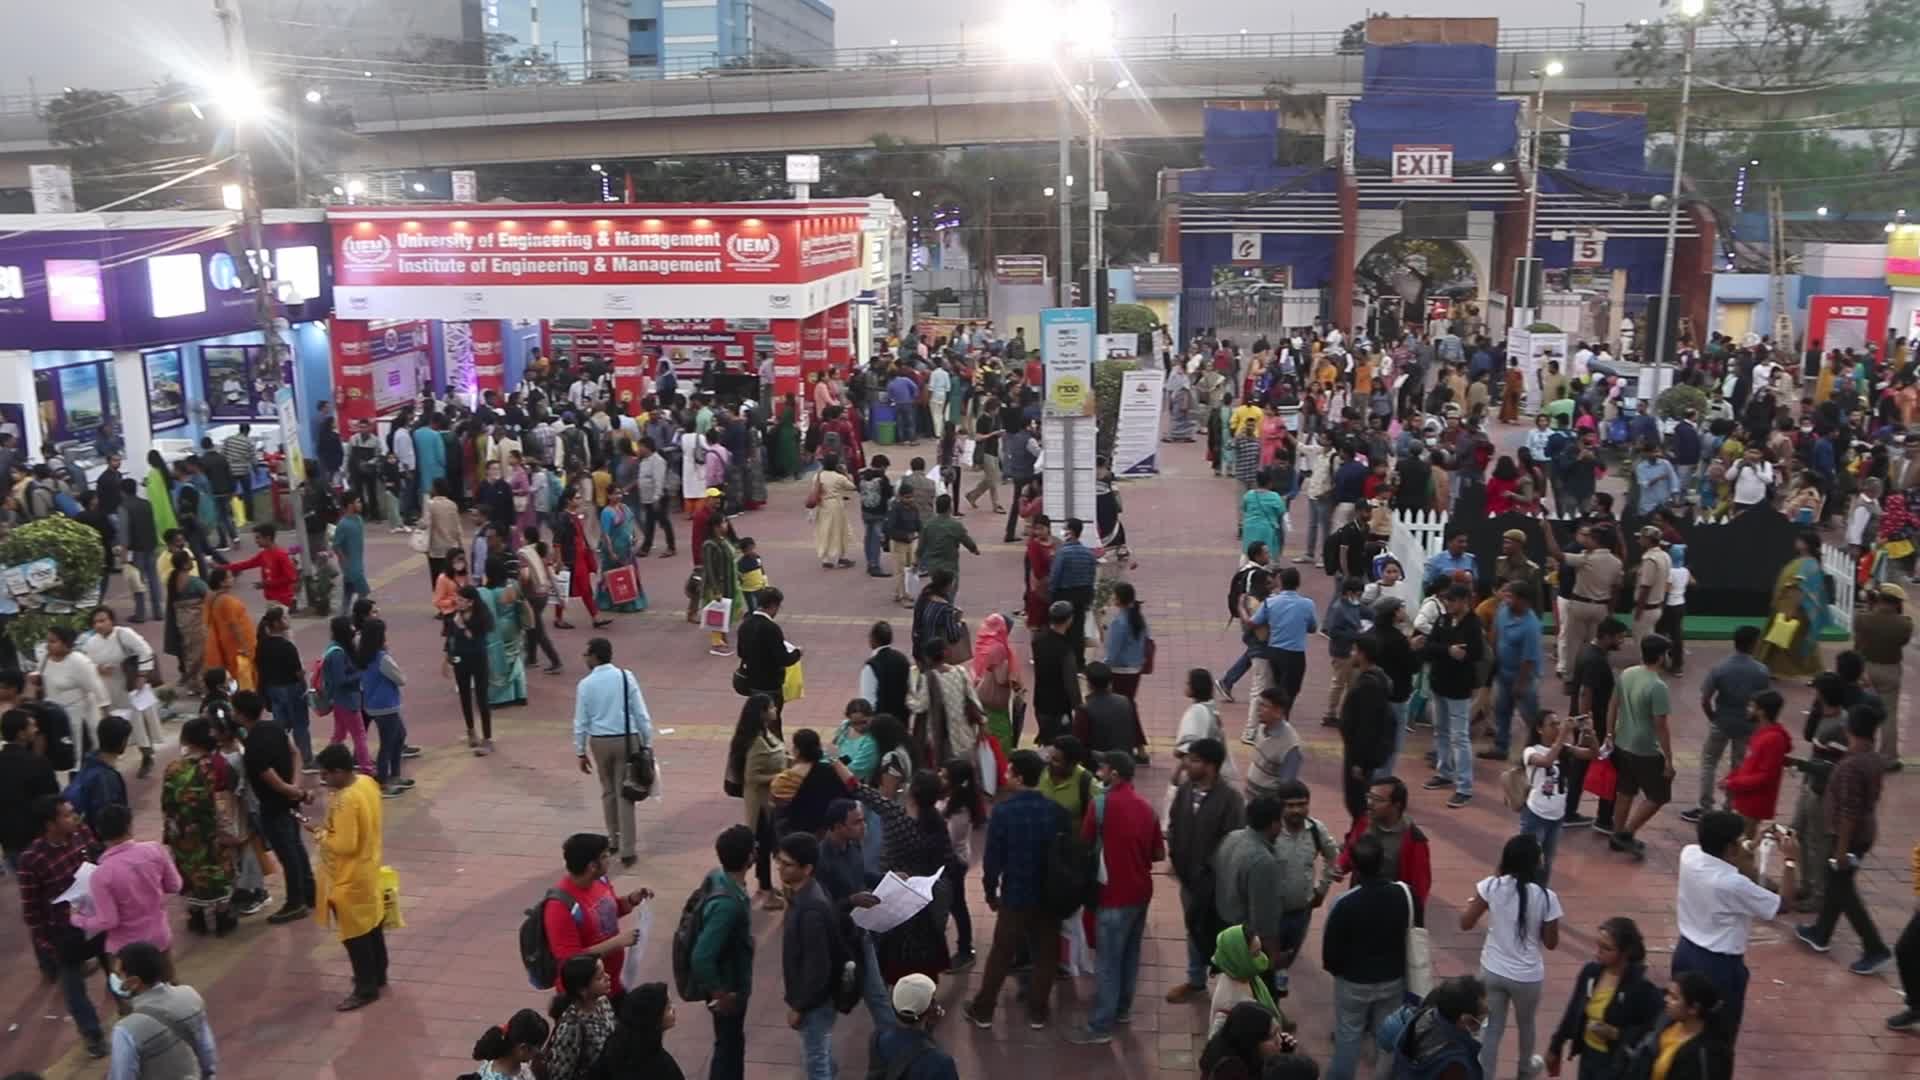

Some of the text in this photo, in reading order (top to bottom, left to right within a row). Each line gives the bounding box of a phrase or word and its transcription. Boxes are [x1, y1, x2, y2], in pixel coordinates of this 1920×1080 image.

[1397, 155, 1448, 175] EXIT
[398, 230, 721, 250] University of Engineering & Management
[736, 239, 770, 253] IEM
[1581, 241, 1597, 258] 5
[398, 256, 721, 275] Institute of Engineering & Management
